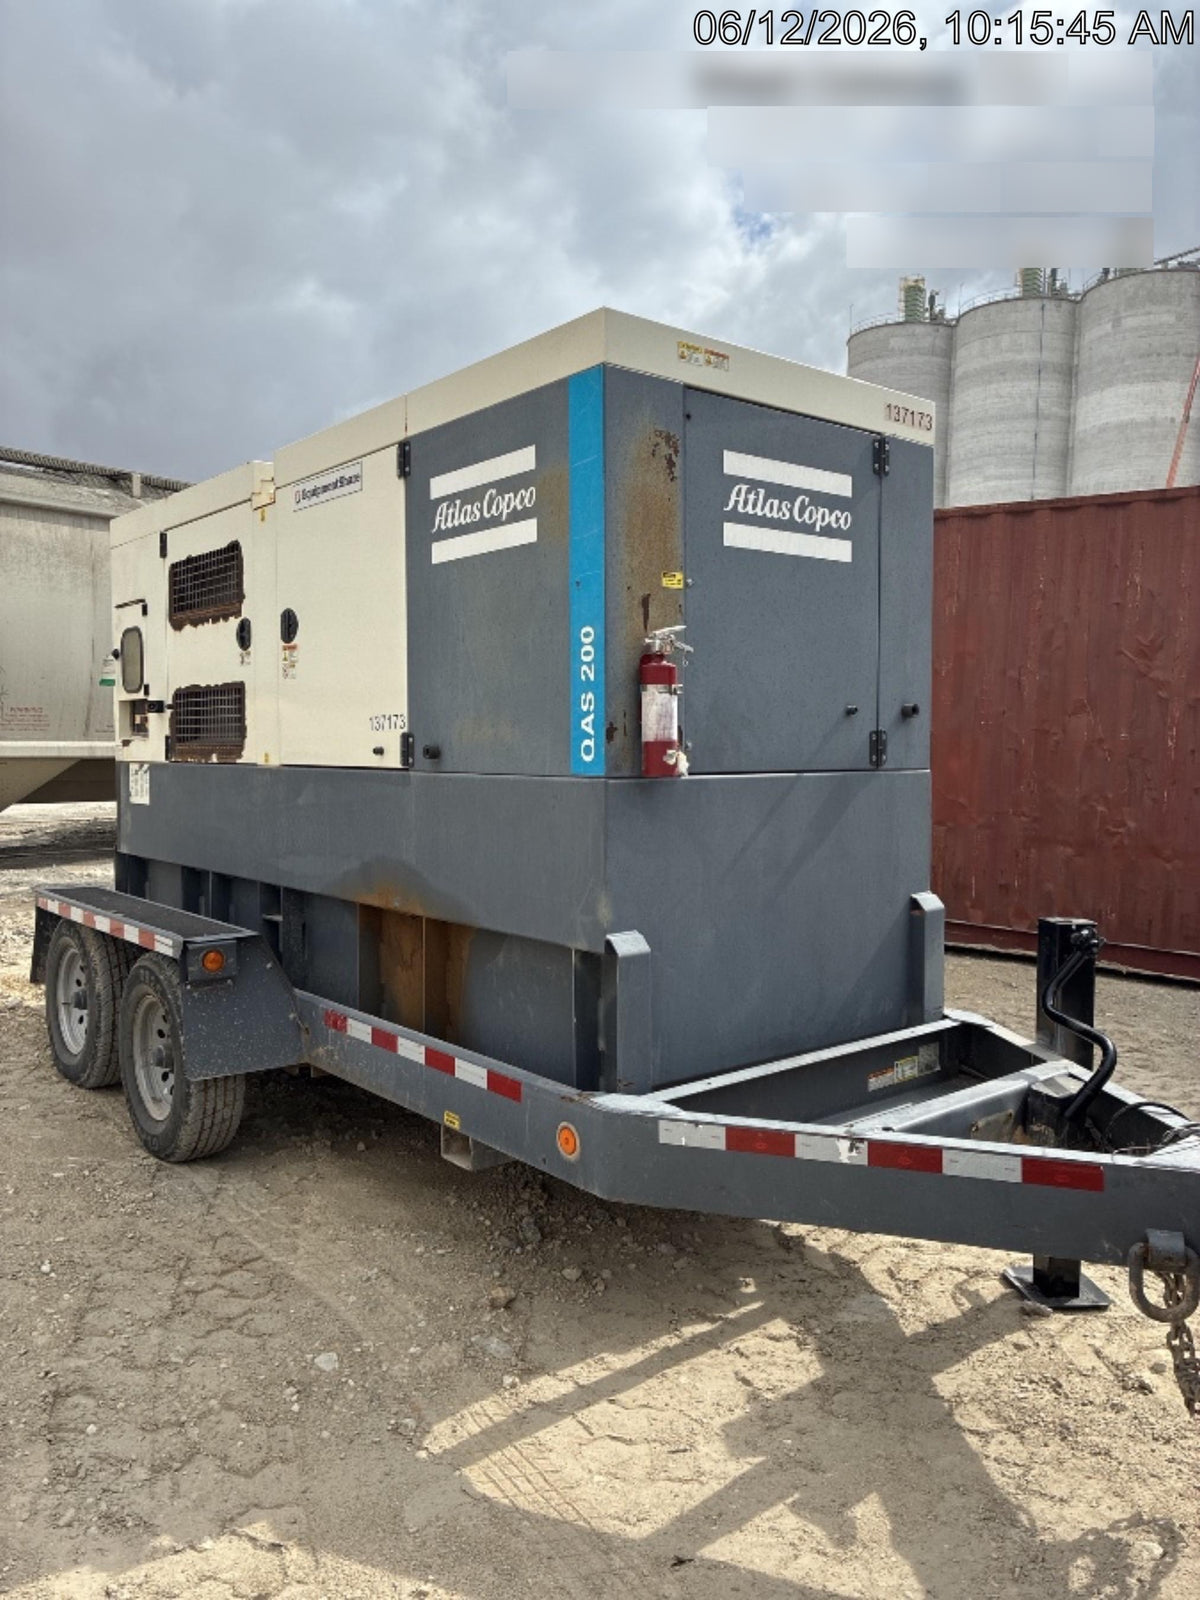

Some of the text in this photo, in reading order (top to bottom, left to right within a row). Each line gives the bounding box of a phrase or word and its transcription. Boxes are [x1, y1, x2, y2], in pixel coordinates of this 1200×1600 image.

[886, 403, 933, 431] 137173
[431, 486, 537, 534] Atlas Copco
[723, 483, 852, 532] Atlas Copco
[580, 625, 595, 762] QAS 200
[369, 714, 406, 731] 137173
